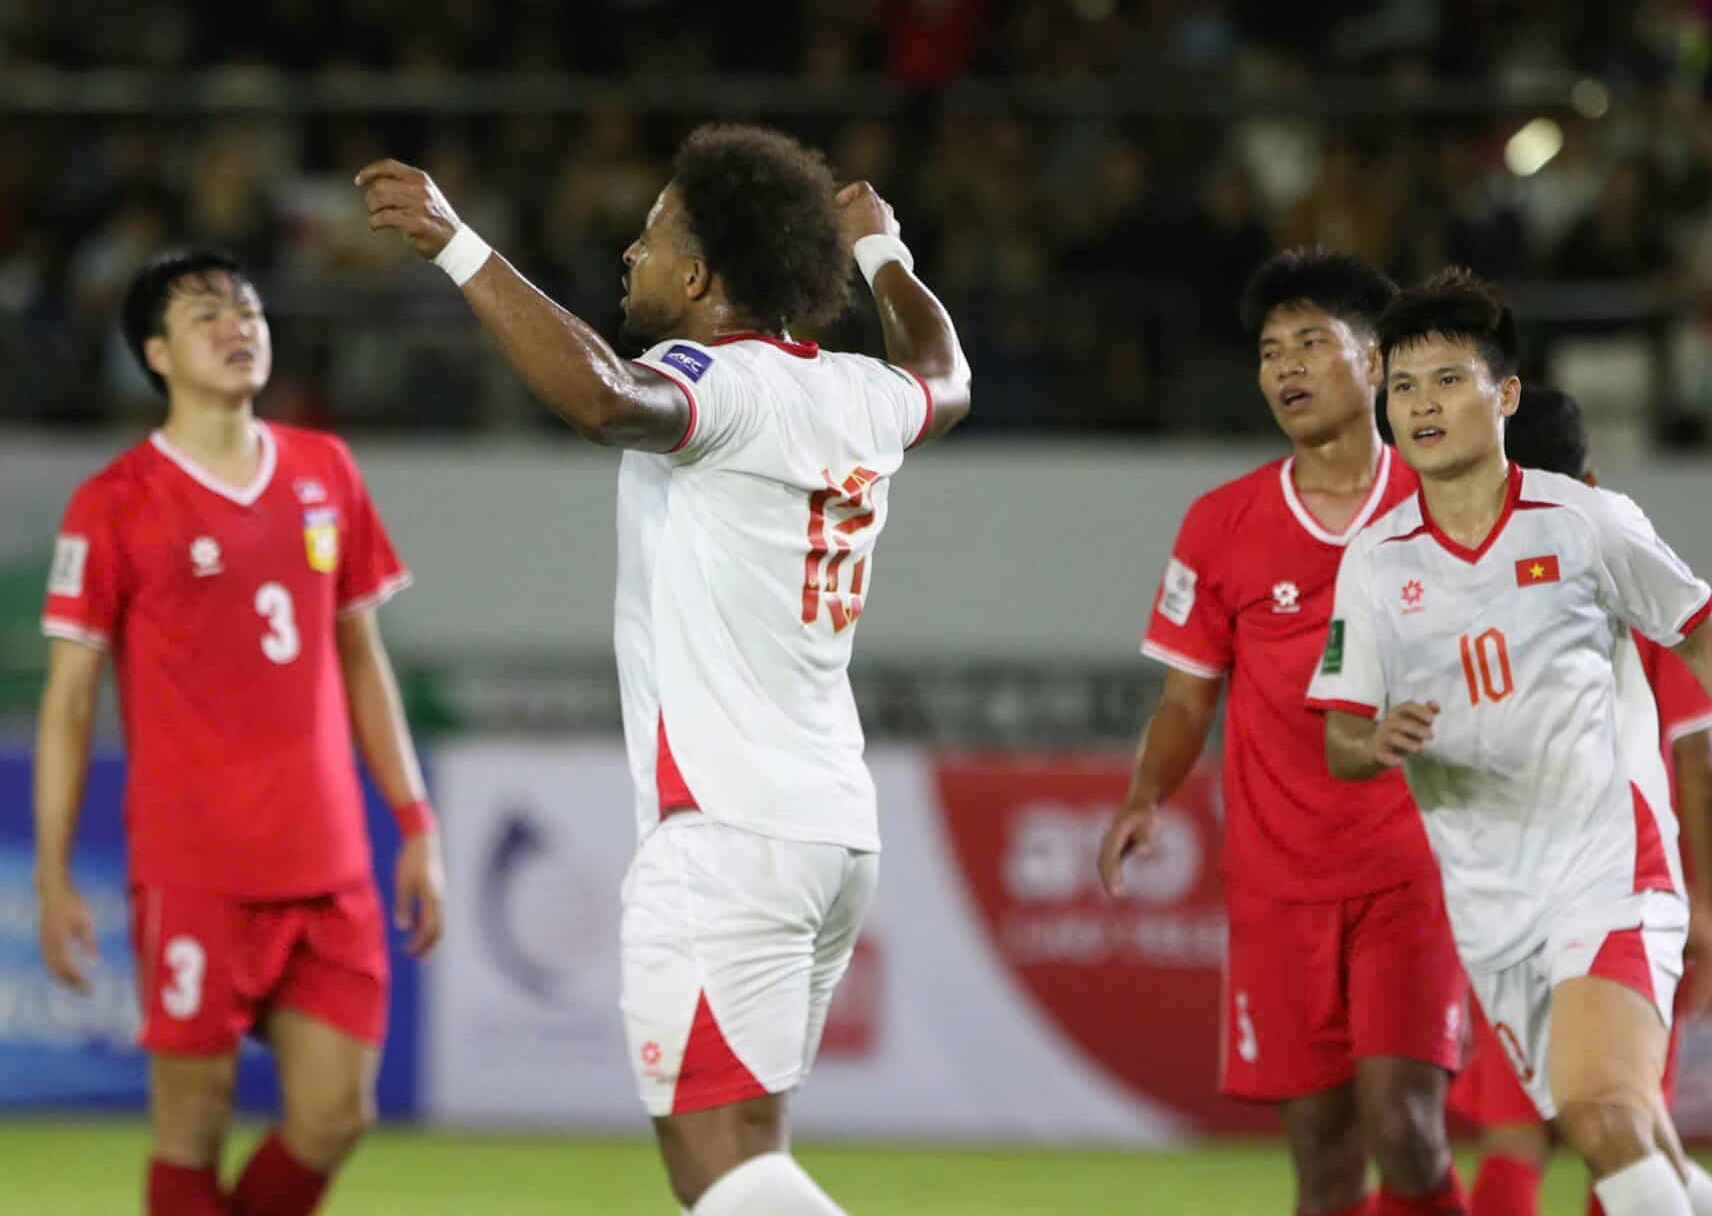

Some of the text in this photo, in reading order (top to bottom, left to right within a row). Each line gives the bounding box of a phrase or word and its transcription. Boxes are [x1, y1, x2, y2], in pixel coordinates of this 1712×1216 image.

[255, 580, 301, 664] 3
[1460, 626, 1514, 707] 10
[161, 935, 208, 1019] 3
